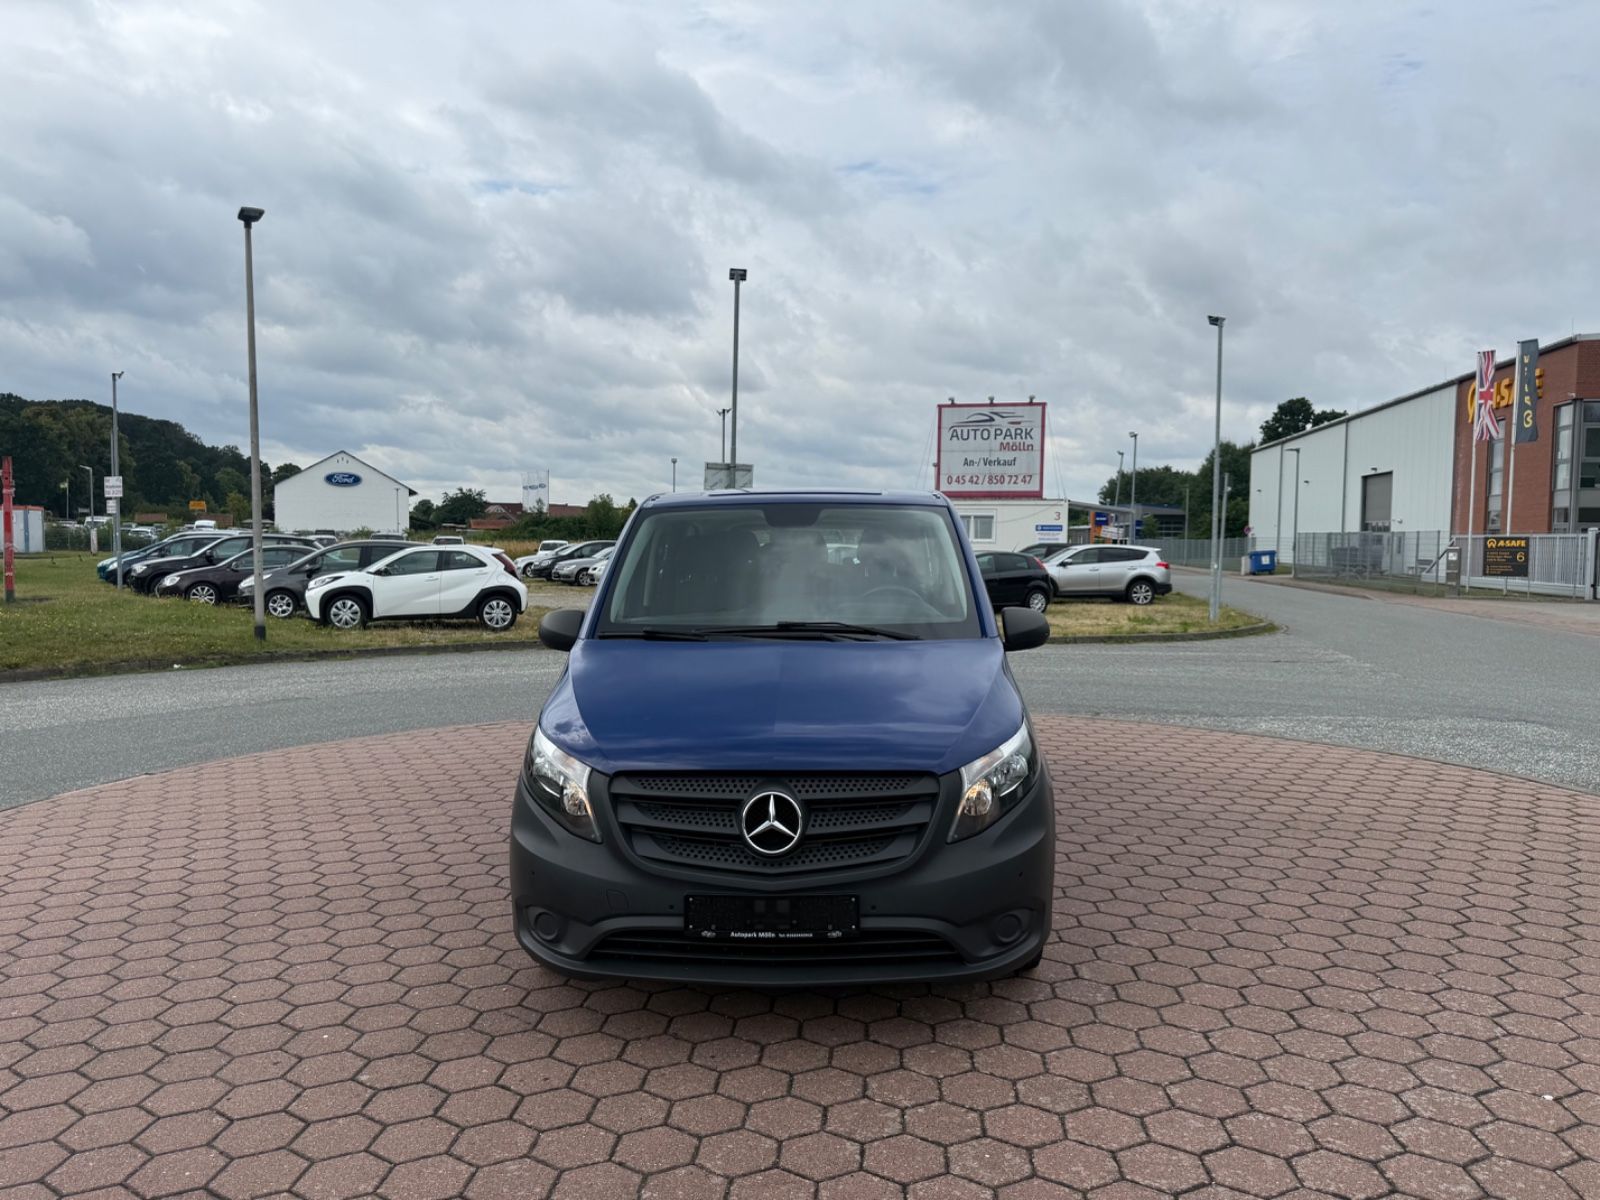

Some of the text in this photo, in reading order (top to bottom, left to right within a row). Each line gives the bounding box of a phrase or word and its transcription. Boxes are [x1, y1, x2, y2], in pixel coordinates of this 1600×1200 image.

[949, 427, 1034, 441] AUTO PARK
[999, 441, 1034, 452] Mölln
[983, 457, 1017, 467] Verkauf
[332, 473, 355, 484] Ford
[947, 475, 953, 485] 0
[955, 475, 966, 485] 45
[968, 475, 980, 485] 42
[987, 475, 1005, 485] 850
[1007, 475, 1019, 485] 72
[1021, 474, 1033, 484] 47
[1054, 512, 1061, 520] 3
[1516, 551, 1525, 562] 6
